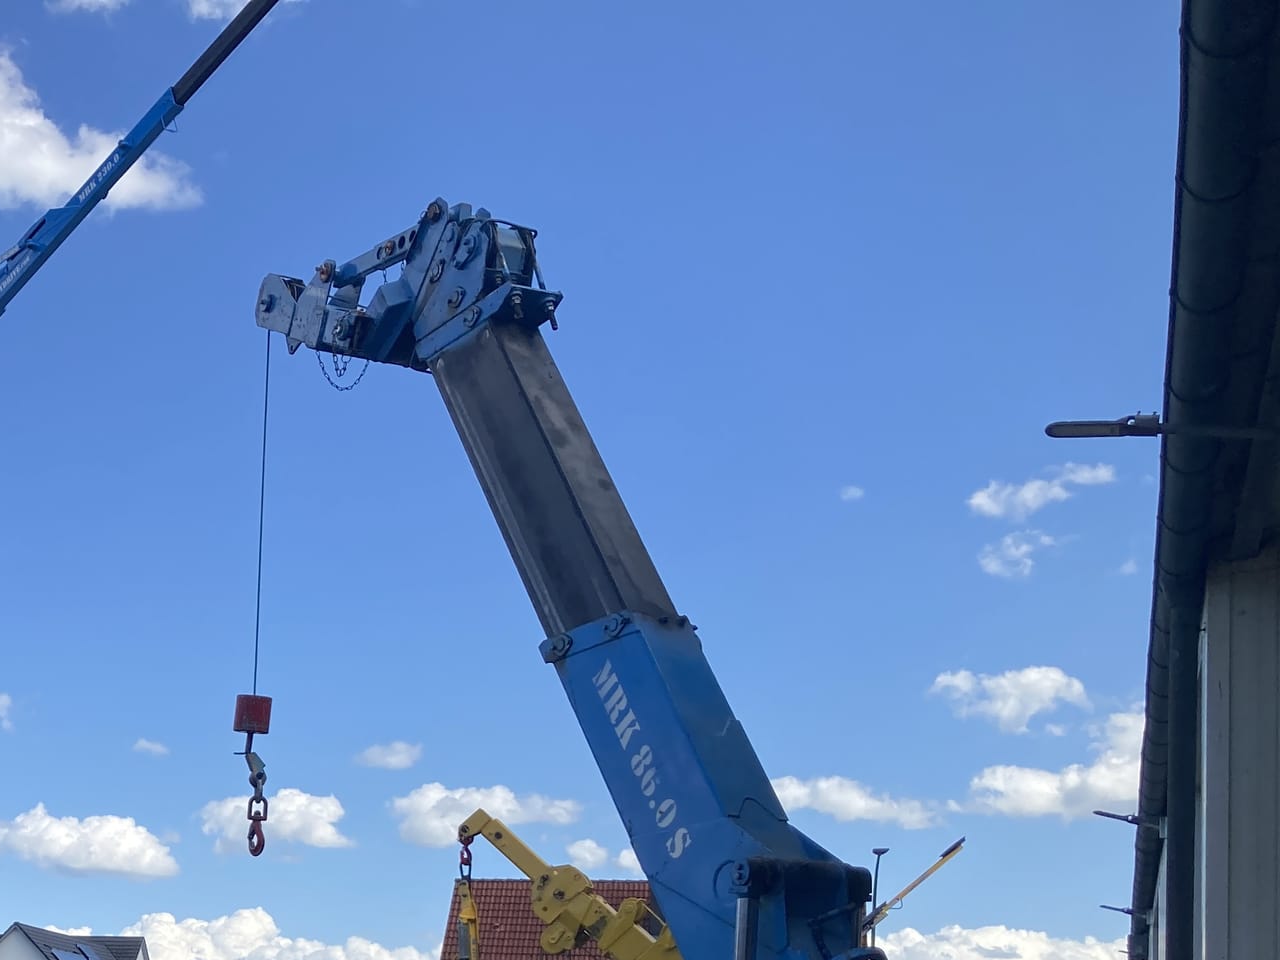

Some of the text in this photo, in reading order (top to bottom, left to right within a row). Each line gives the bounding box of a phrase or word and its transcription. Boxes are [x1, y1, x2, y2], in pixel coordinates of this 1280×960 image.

[591, 658, 692, 859] MRK 86.0 S
